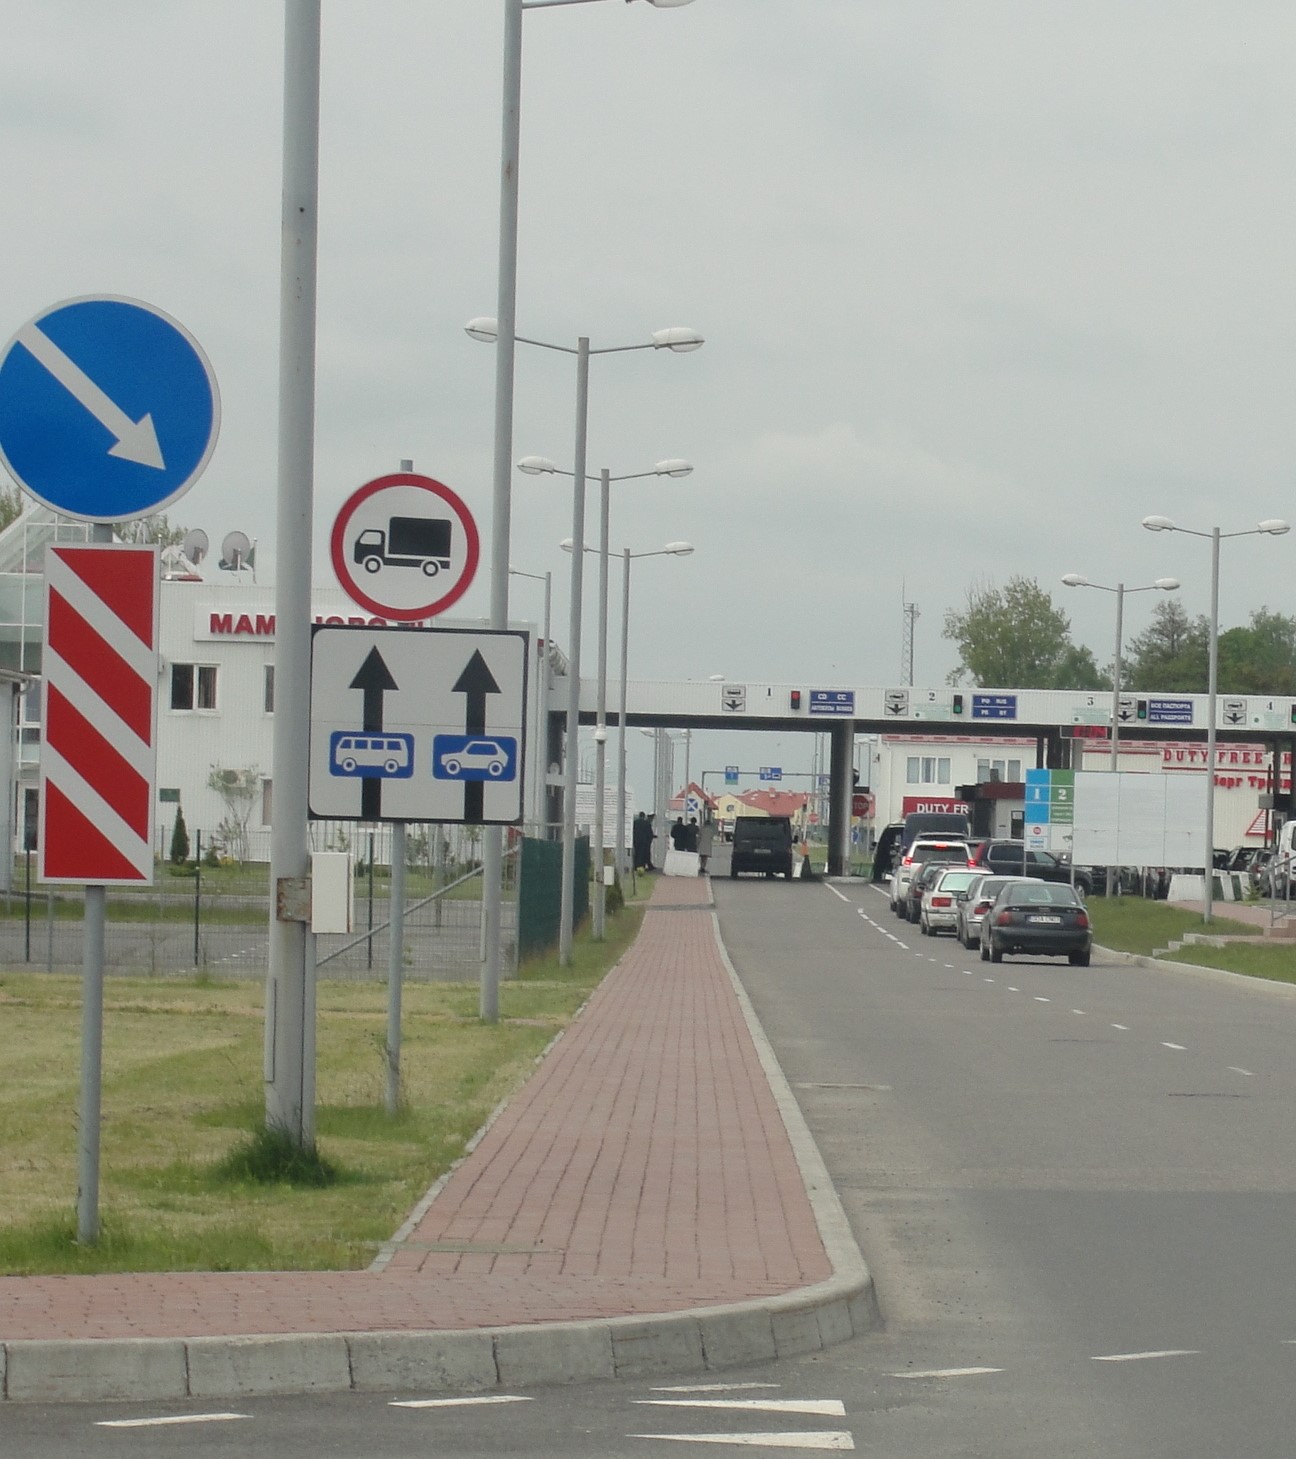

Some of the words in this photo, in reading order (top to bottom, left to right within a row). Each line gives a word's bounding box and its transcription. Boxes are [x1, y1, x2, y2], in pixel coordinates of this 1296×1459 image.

[928, 691, 936, 702] 2
[1087, 696, 1094, 706] 3
[1163, 749, 1208, 763] DUTY
[1218, 751, 1263, 764] FREE
[1034, 788, 1041, 800] 1
[1058, 788, 1067, 800] 2
[916, 803, 949, 814] DUTY
